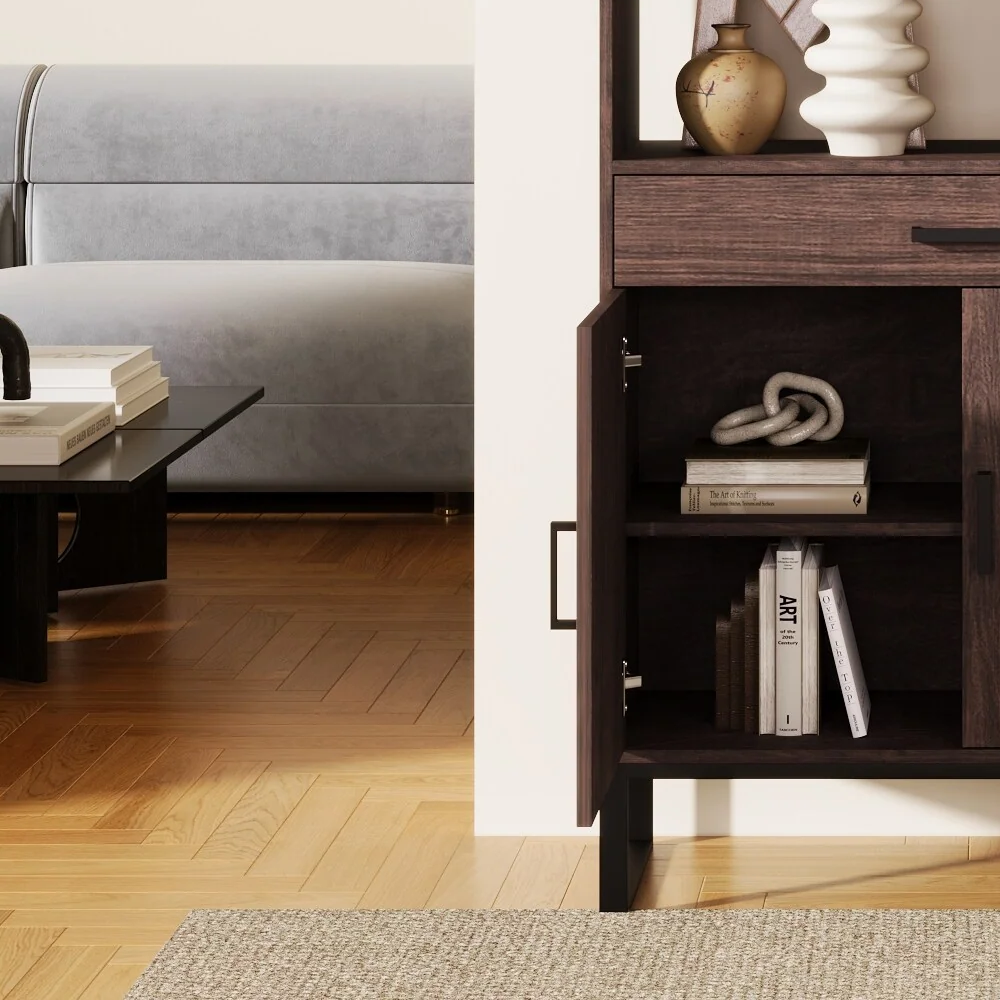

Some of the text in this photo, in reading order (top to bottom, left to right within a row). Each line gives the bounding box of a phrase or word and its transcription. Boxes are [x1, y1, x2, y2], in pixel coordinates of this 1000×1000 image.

[709, 490, 757, 501] The Art of Knitting
[779, 594, 797, 624] ART
[822, 595, 836, 630] Over
[834, 640, 845, 666] the
